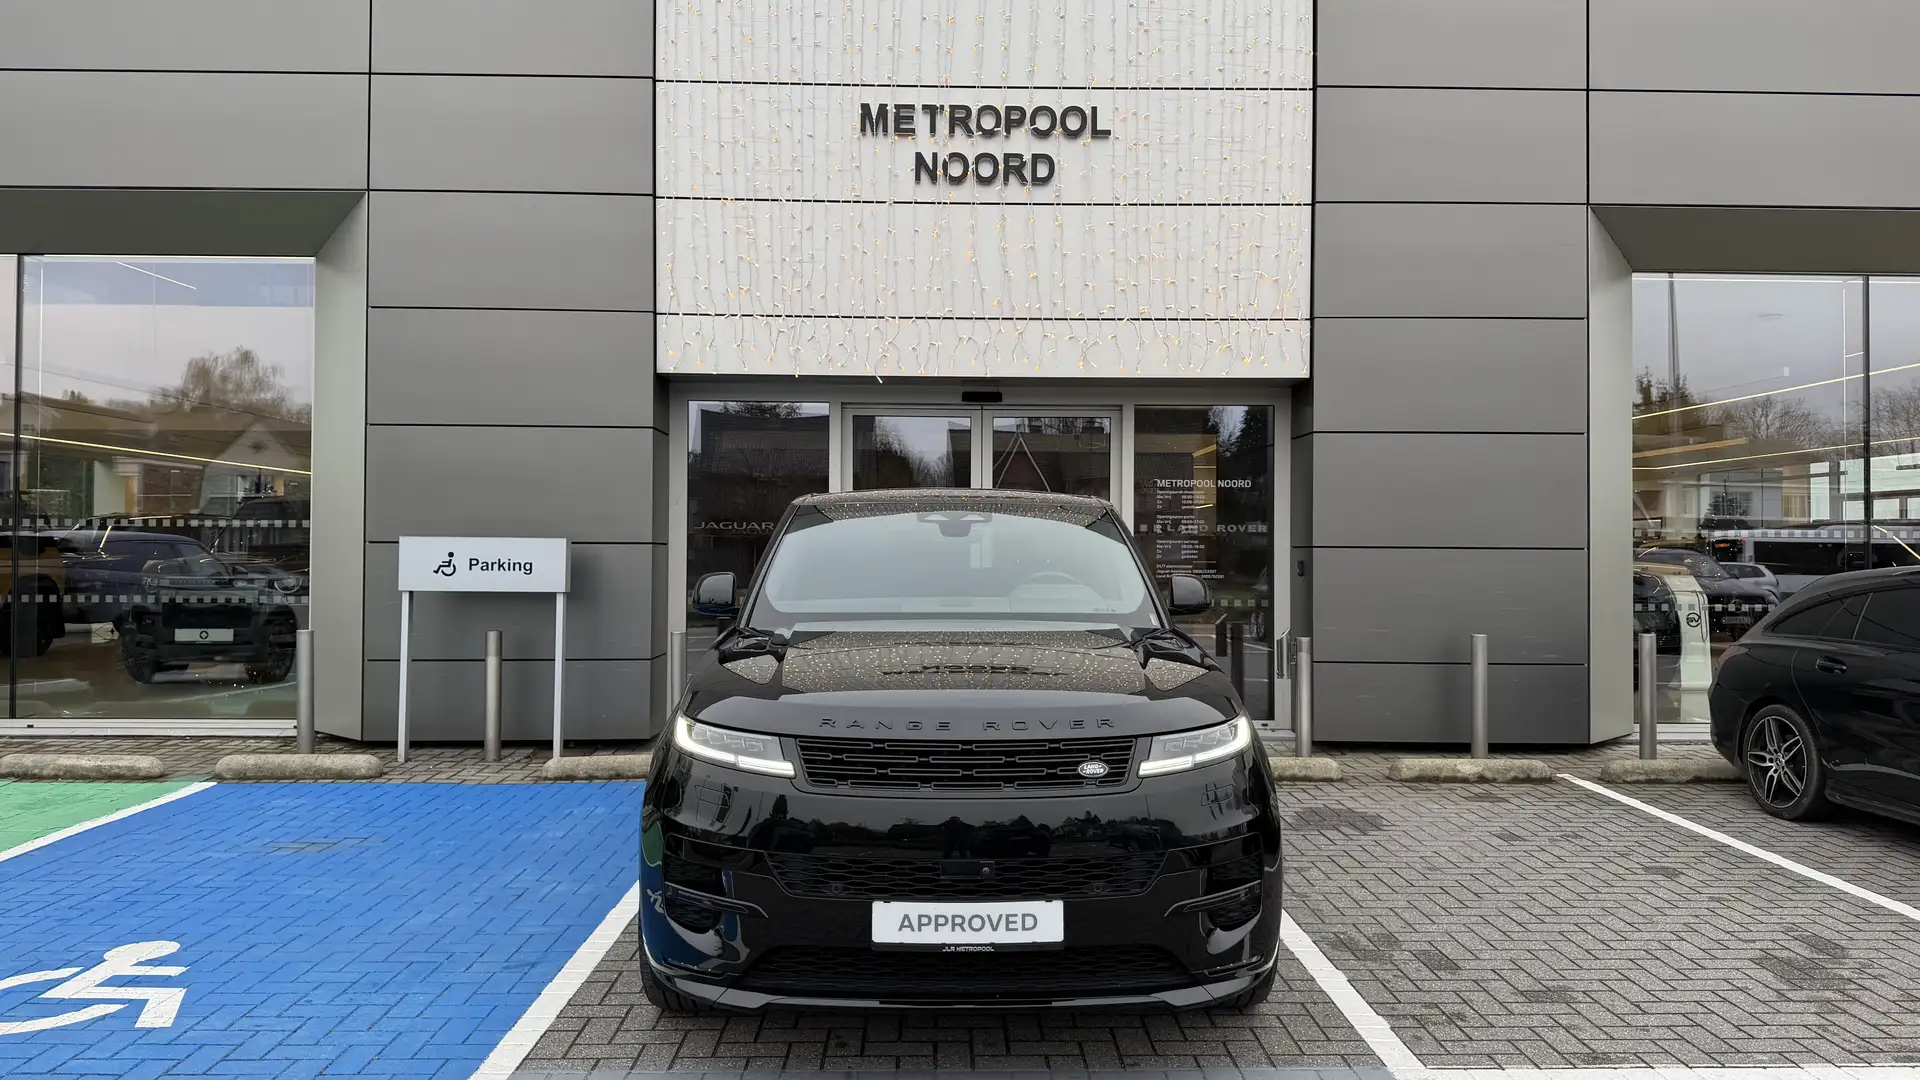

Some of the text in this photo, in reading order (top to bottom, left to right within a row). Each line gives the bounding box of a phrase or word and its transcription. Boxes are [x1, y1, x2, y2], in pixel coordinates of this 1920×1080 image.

[859, 102, 1112, 137] METROPOOL
[914, 151, 1056, 186] NOORD
[1156, 479, 1252, 488] METROPOOL NOORD
[693, 521, 775, 530] JAGUAR
[1216, 524, 1268, 532] ROVER
[468, 558, 533, 576] Parking
[818, 717, 1115, 731] RANGE ROVER
[897, 912, 1039, 932] APPROVED
